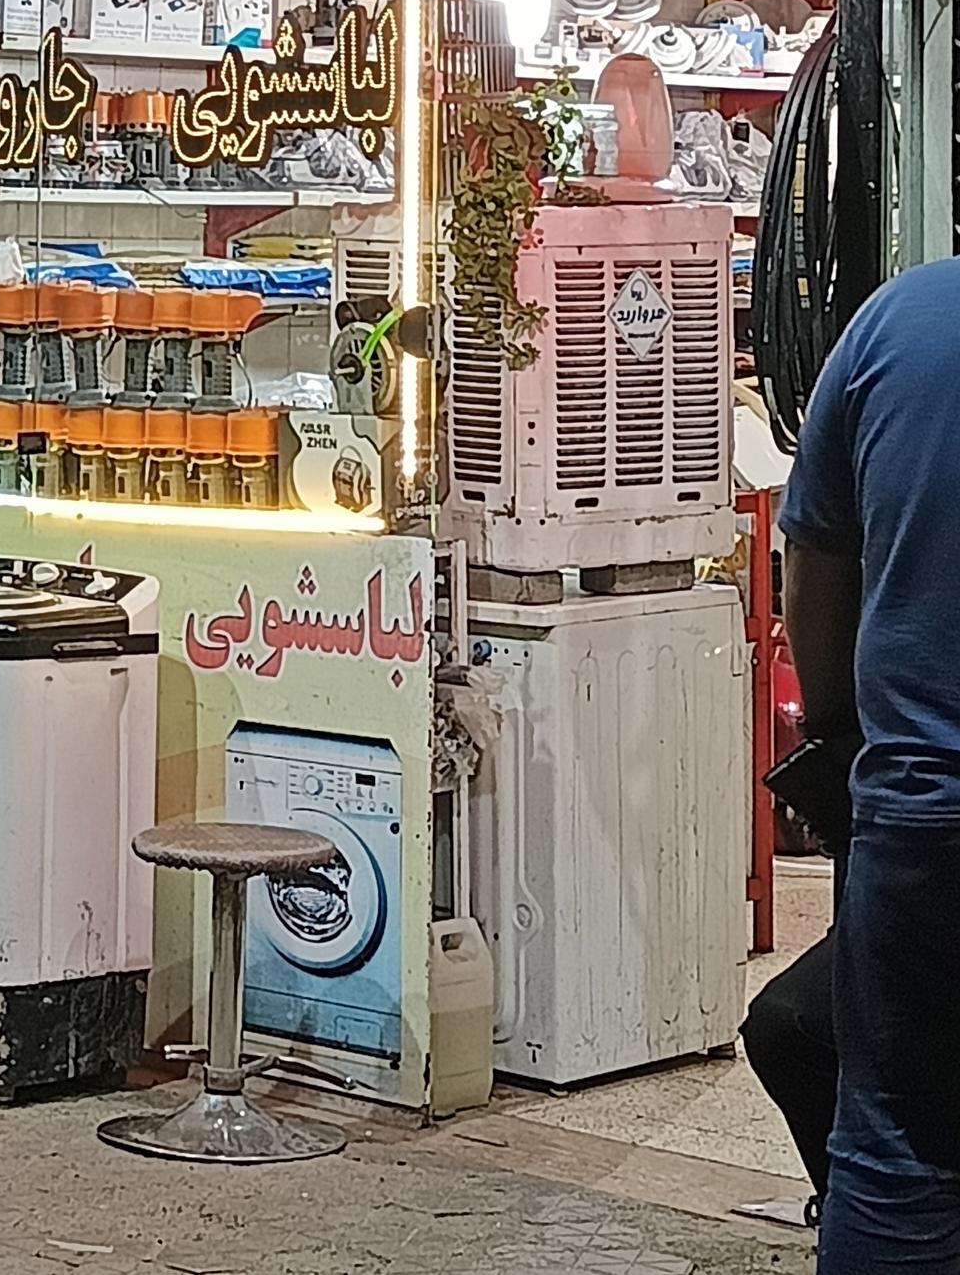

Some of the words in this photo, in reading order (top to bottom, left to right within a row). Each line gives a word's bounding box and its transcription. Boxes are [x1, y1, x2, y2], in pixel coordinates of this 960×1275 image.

[171, 5, 399, 165] لباسشویی
[306, 436, 338, 450] ZHEN
[182, 564, 429, 691] لباسشویی
